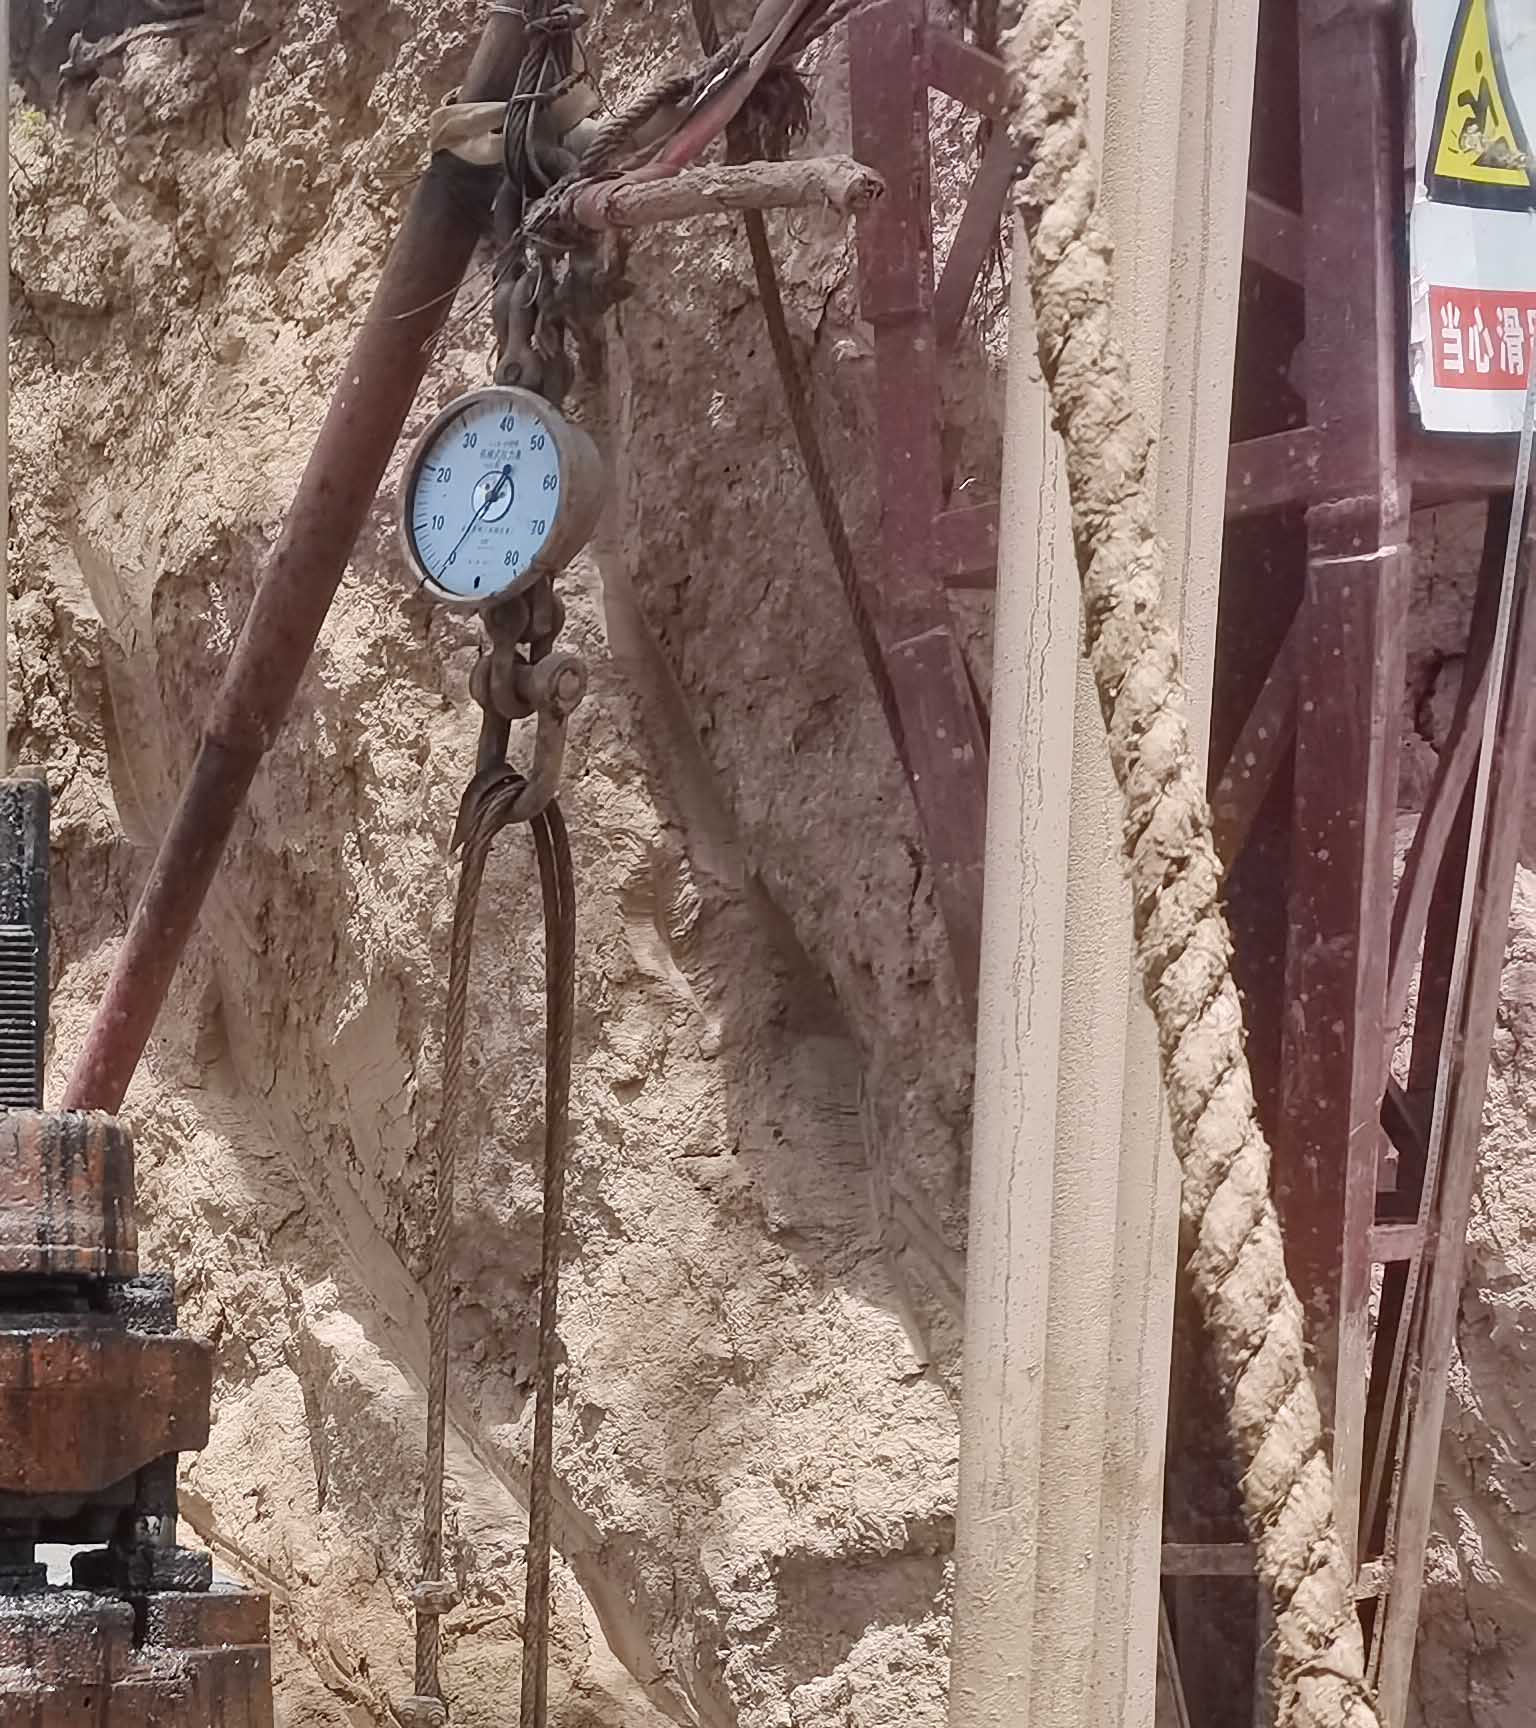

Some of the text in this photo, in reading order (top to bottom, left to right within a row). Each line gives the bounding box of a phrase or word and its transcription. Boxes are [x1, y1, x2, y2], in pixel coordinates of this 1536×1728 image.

[499, 416, 514, 432] 40
[462, 433, 477, 448] 30
[530, 434, 545, 450] 50
[436, 467, 451, 483] 20
[543, 474, 557, 491] 60
[432, 515, 444, 530] 10
[531, 519, 546, 536] 70
[504, 550, 519, 566] 80
